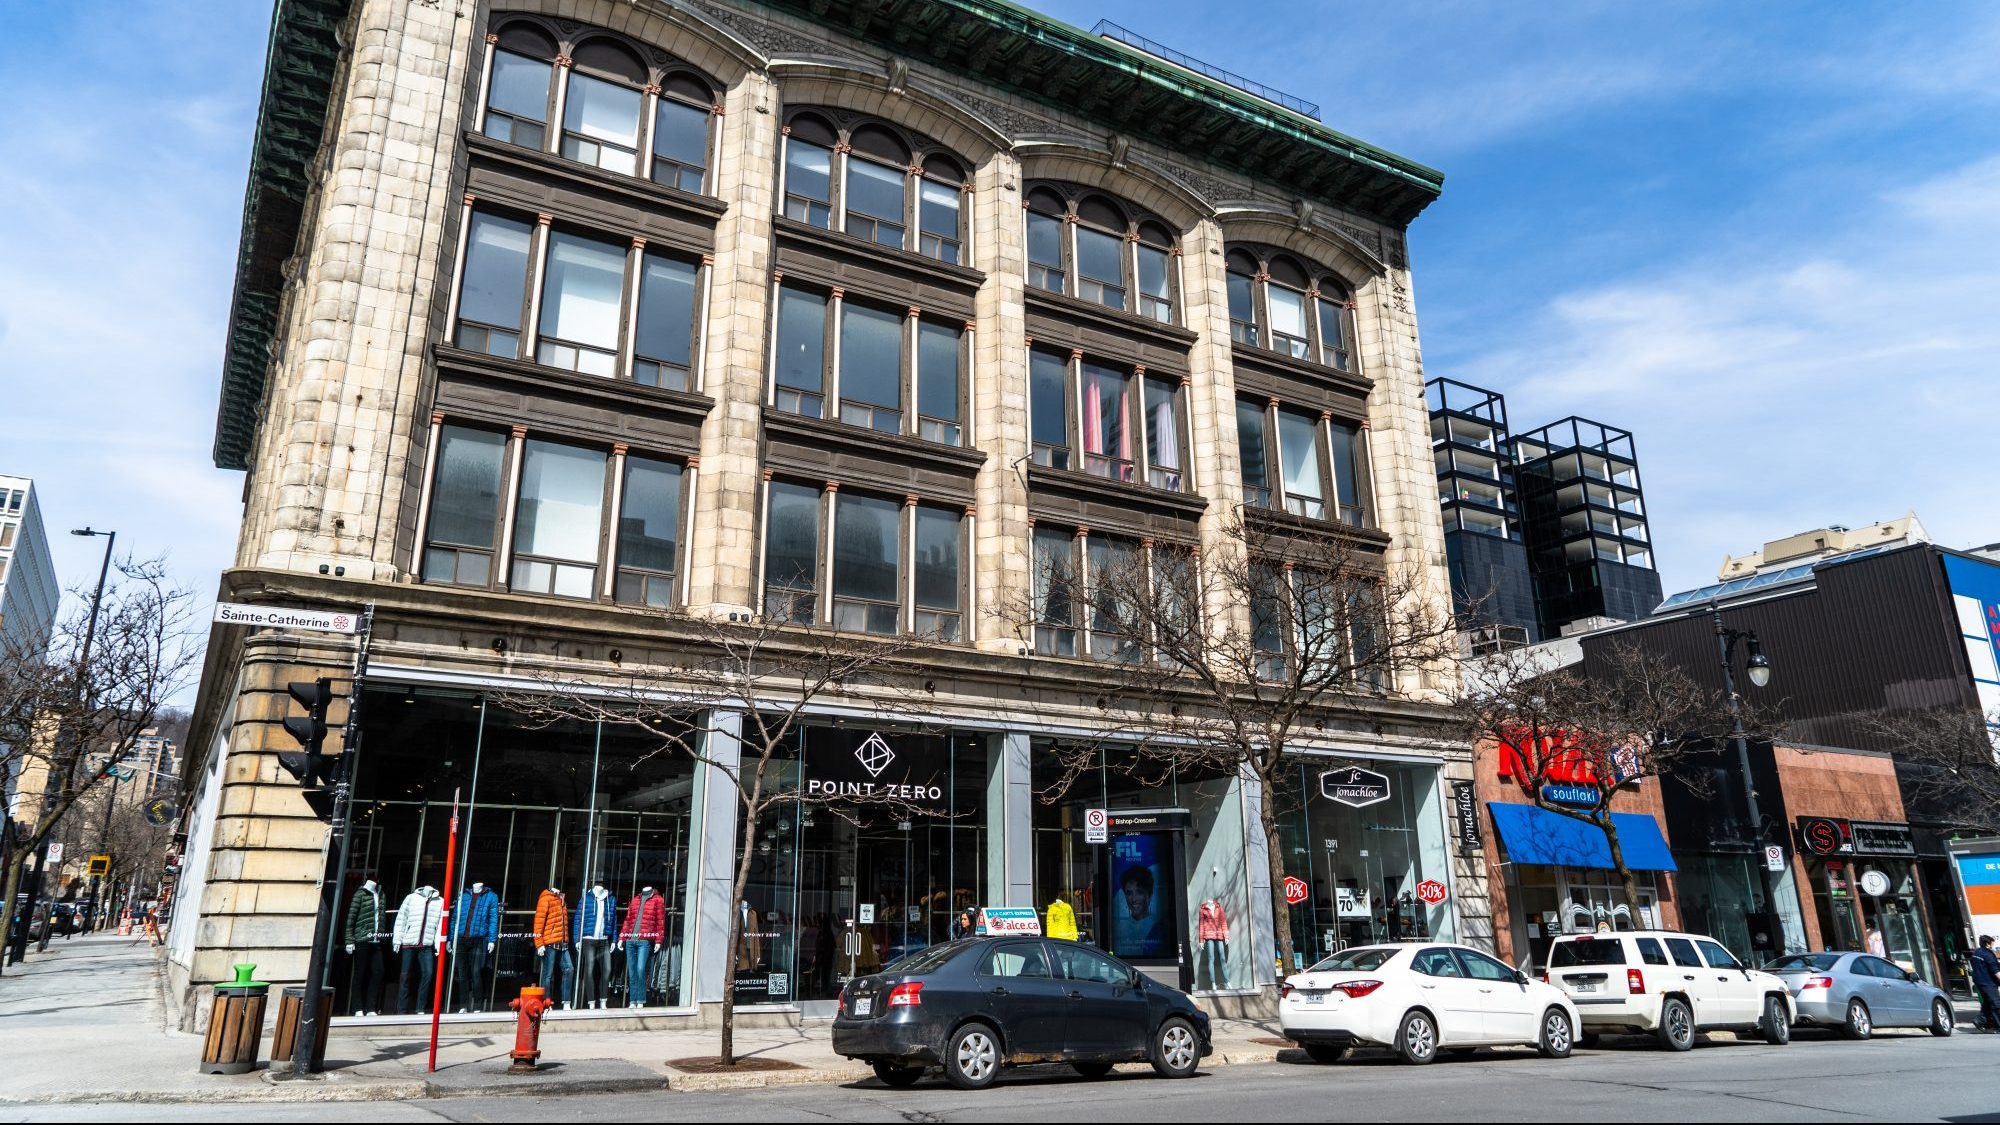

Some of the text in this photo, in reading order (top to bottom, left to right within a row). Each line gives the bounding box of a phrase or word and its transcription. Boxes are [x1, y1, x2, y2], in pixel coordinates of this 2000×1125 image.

[221, 609, 330, 628] Sainte-Catherine
[1347, 770, 1361, 784] jc
[809, 780, 941, 800] POINT ZERO
[1336, 786, 1378, 798] jonachloe
[1553, 788, 1596, 803] souflaki
[1115, 817, 1157, 825] Bishop-Crescent
[1459, 786, 1480, 847] jonachloe
[1325, 839, 1338, 849] 1391
[1286, 883, 1304, 898] 0%
[1420, 884, 1443, 899] 50%
[1006, 920, 1039, 931] alce.ca
